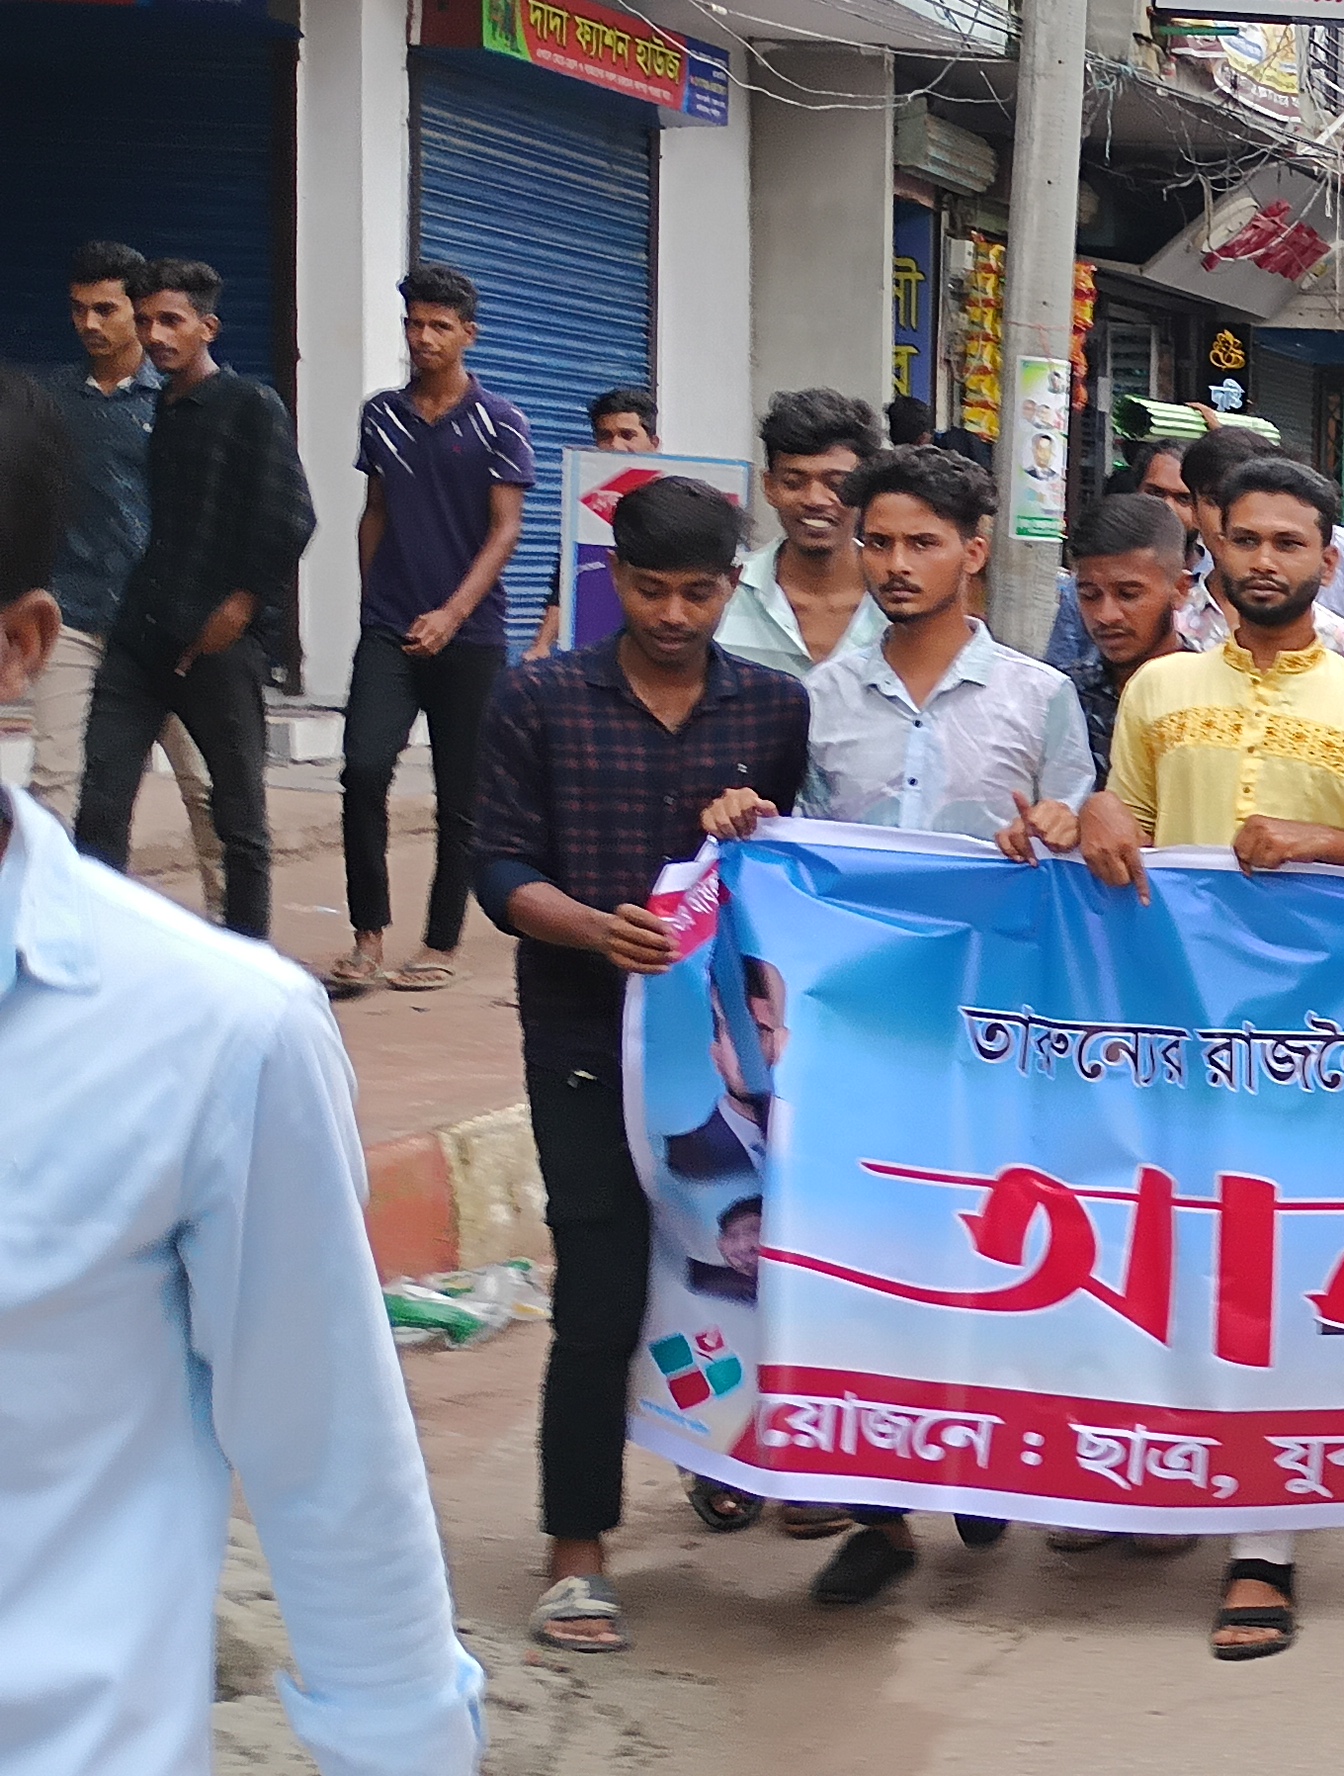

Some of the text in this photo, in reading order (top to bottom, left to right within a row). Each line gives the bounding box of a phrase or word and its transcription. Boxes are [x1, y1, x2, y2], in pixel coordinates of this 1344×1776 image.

[528, 0, 569, 46] দাদা
[574, 15, 632, 70] ফ্যাশন
[634, 33, 682, 84] হাউজ
[757, 1390, 1005, 1467] য়োজনে
[1072, 1420, 1239, 1500] ছাত্র,
